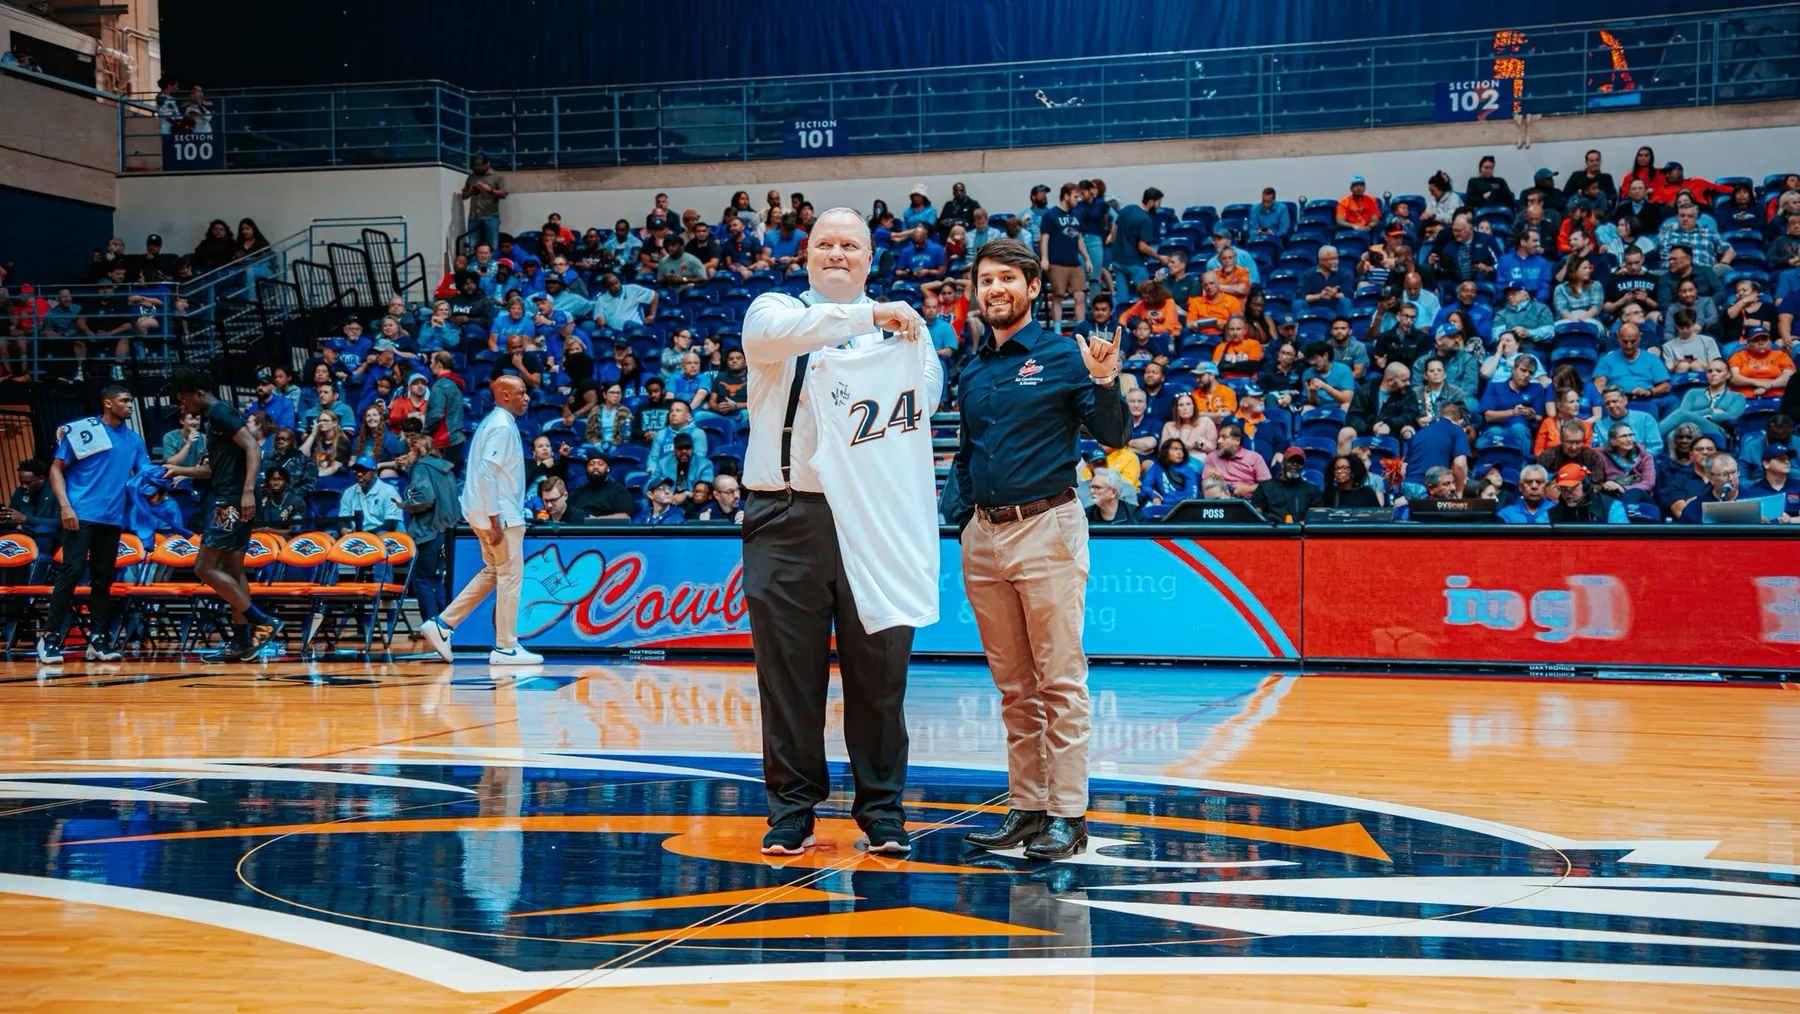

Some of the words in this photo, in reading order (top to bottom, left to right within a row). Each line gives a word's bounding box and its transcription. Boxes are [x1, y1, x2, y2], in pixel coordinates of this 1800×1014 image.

[1449, 79, 1500, 91] SECTION
[1449, 89, 1499, 112] 102
[795, 120, 837, 129] SECTION
[174, 134, 213, 142] SECTION
[798, 129, 834, 148] 101
[174, 142, 213, 160] 100
[1617, 281, 1632, 291] SAN
[1634, 280, 1655, 290] DIEGO
[848, 387, 922, 447] 24
[1203, 508, 1225, 519] POSS
